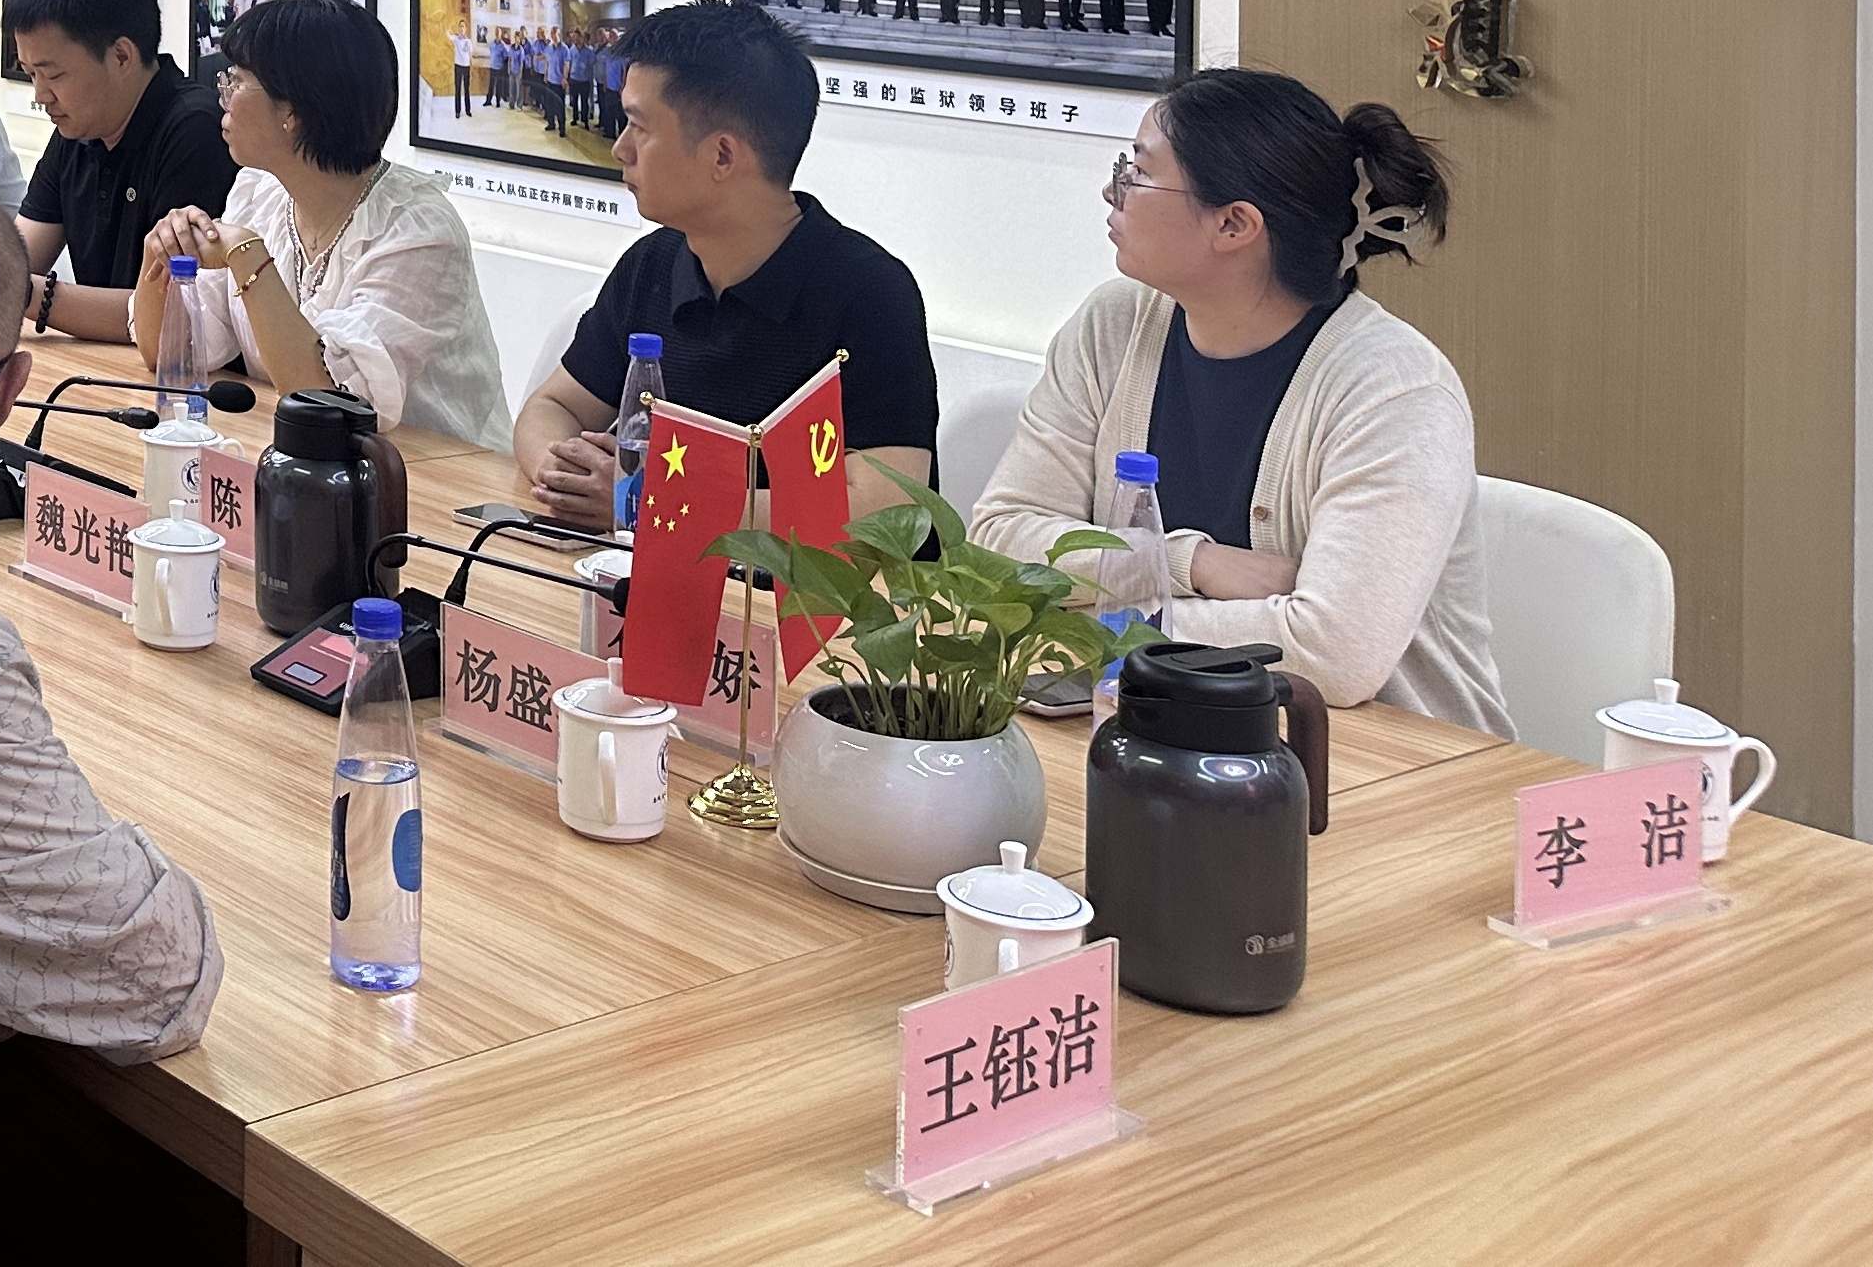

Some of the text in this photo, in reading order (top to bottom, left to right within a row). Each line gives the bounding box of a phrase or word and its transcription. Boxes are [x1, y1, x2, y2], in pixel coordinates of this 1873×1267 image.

[826, 76, 1080, 123] 坚强的监狱领导班子
[434, 169, 619, 216] 长鸣，工人队伍正在开展警示教育
[209, 474, 243, 531] 陈
[455, 638, 560, 735] 杨盛
[919, 994, 1101, 1134] 王钰洁
